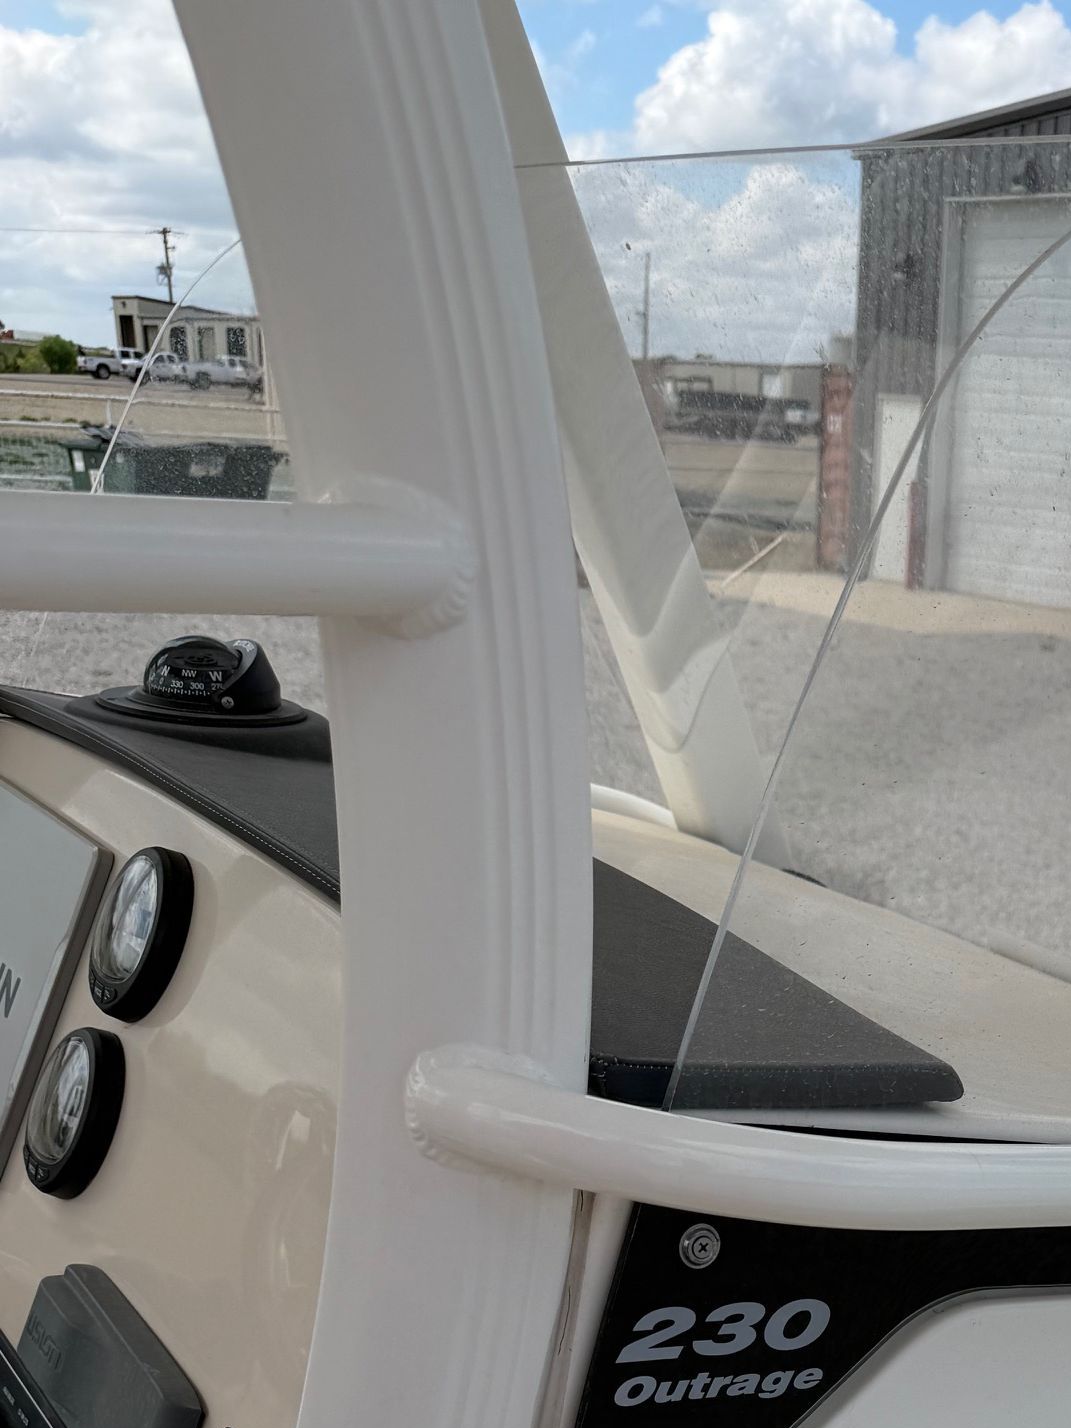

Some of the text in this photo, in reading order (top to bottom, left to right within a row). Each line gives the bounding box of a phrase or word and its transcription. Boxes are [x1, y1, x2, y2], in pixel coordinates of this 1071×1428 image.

[170, 680, 184, 688] 330
[190, 682, 204, 690] 300
[181, 669, 197, 678] NW
[209, 671, 222, 682] W
[615, 1299, 831, 1364] 230
[614, 1367, 824, 1407] Outrage
